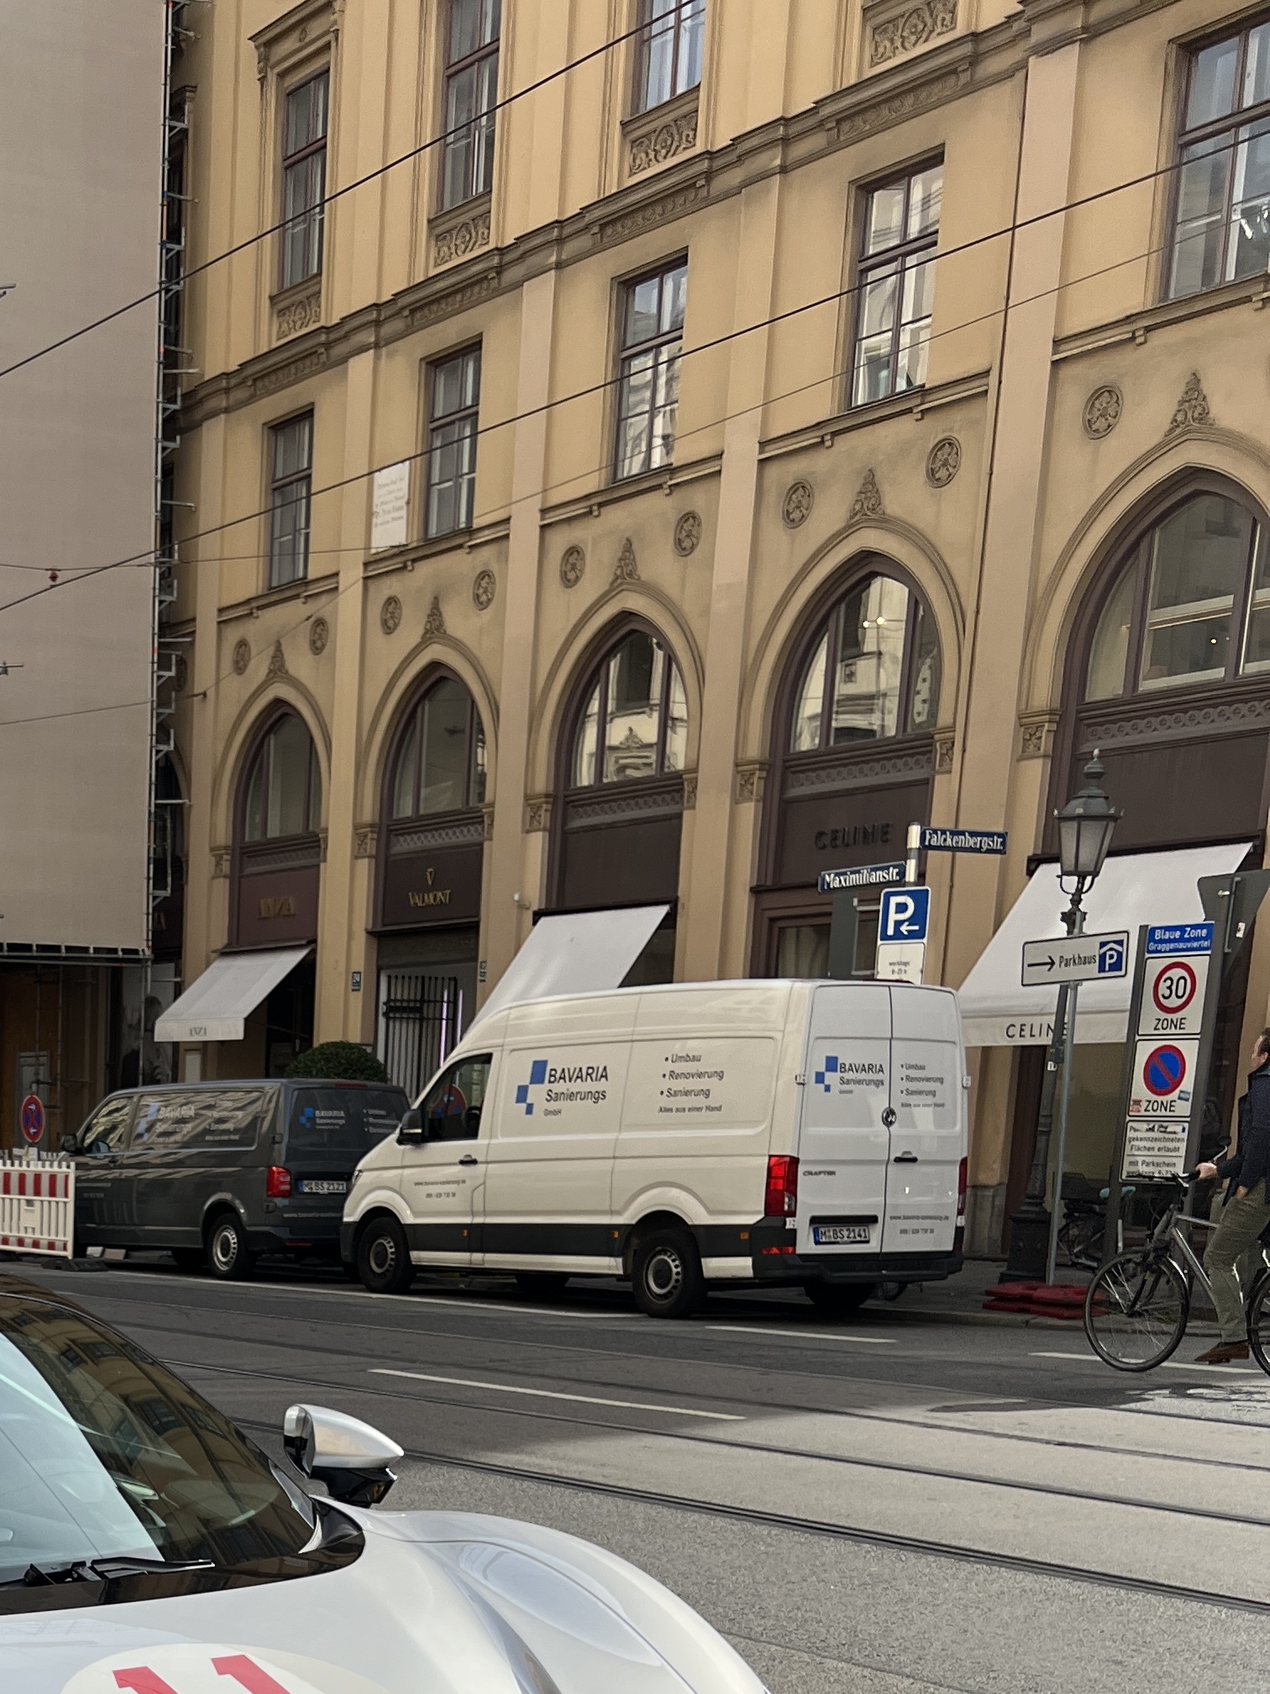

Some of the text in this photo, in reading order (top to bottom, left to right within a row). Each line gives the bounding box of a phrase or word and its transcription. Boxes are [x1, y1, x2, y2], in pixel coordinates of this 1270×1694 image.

[814, 822, 894, 850] CELINE
[924, 829, 1004, 852] Falckenbergstr.
[823, 866, 900, 890] Maximilianstr.
[407, 889, 451, 907] VALMONT
[887, 895, 915, 936] P
[1154, 927, 1208, 940] Blaue Zone
[1058, 953, 1097, 969] Parkhaus
[1161, 975, 1188, 1000] 30
[1153, 1017, 1187, 1031] ZONE
[671, 1053, 702, 1063] Umbau
[548, 1065, 608, 1084] BAVARIA
[839, 1062, 885, 1074] BAVARIA
[668, 1069, 724, 1081] Renovierung
[839, 1076, 885, 1089] Sanierungs
[545, 1088, 607, 1104] Sanierungs
[666, 1087, 710, 1099] Sanierung
[904, 1088, 936, 1098] Sanierung
[543, 1108, 562, 1117] GmbH
[1143, 1100, 1177, 1112] ZONE
[1130, 1144, 1180, 1153] Flächen erlaubt
[1141, 1160, 1177, 1168] Parkschein
[315, 1181, 325, 1191] BS
[326, 1181, 345, 1191] 2121
[820, 1228, 868, 1240] M BS 2141
